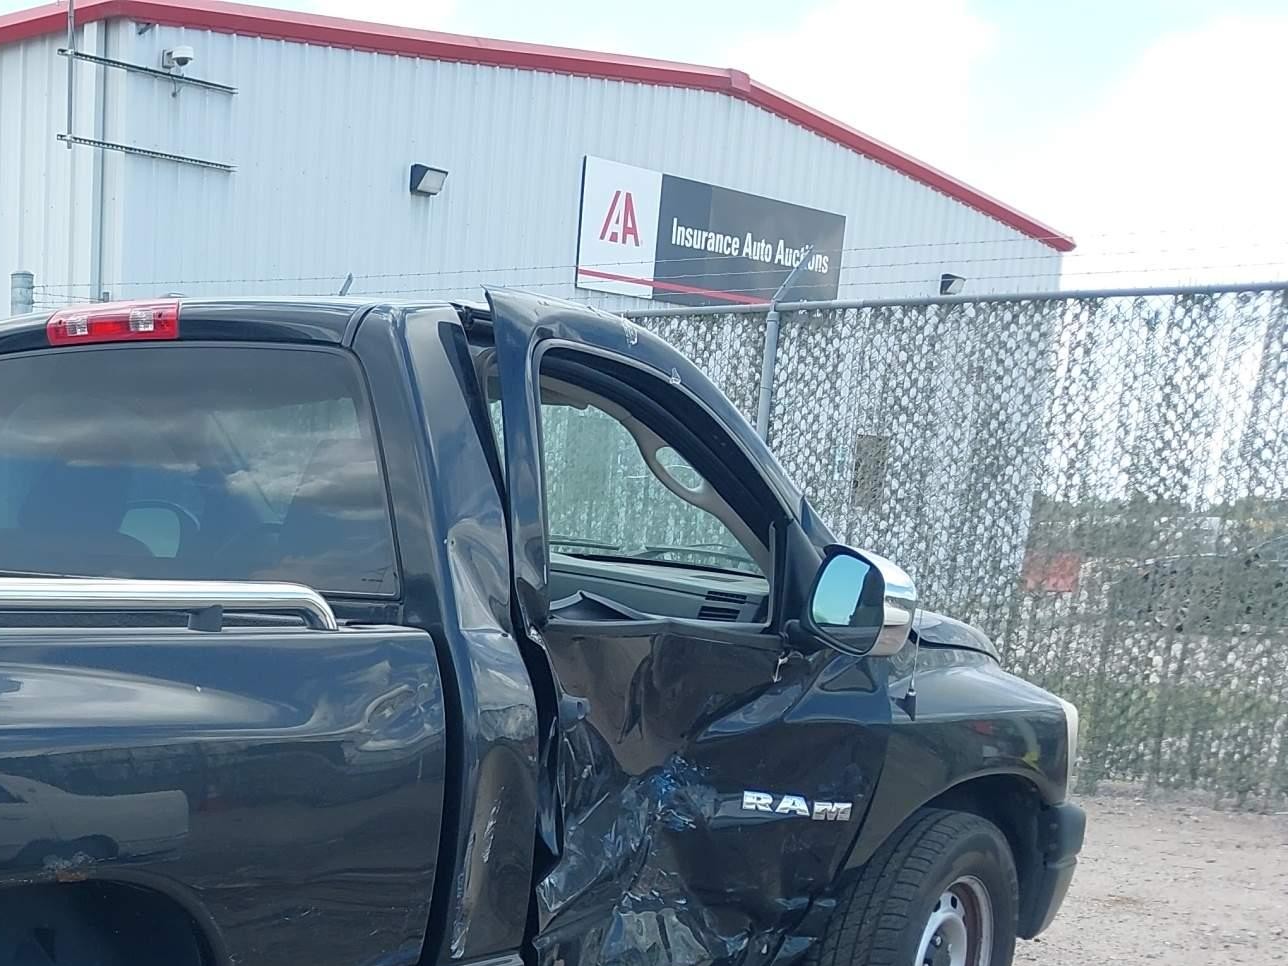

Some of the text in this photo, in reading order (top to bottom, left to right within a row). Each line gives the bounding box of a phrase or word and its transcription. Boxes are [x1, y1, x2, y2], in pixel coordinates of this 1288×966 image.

[672, 217, 829, 274] Insurance Auto Auctons
[742, 790, 852, 820] RAM
